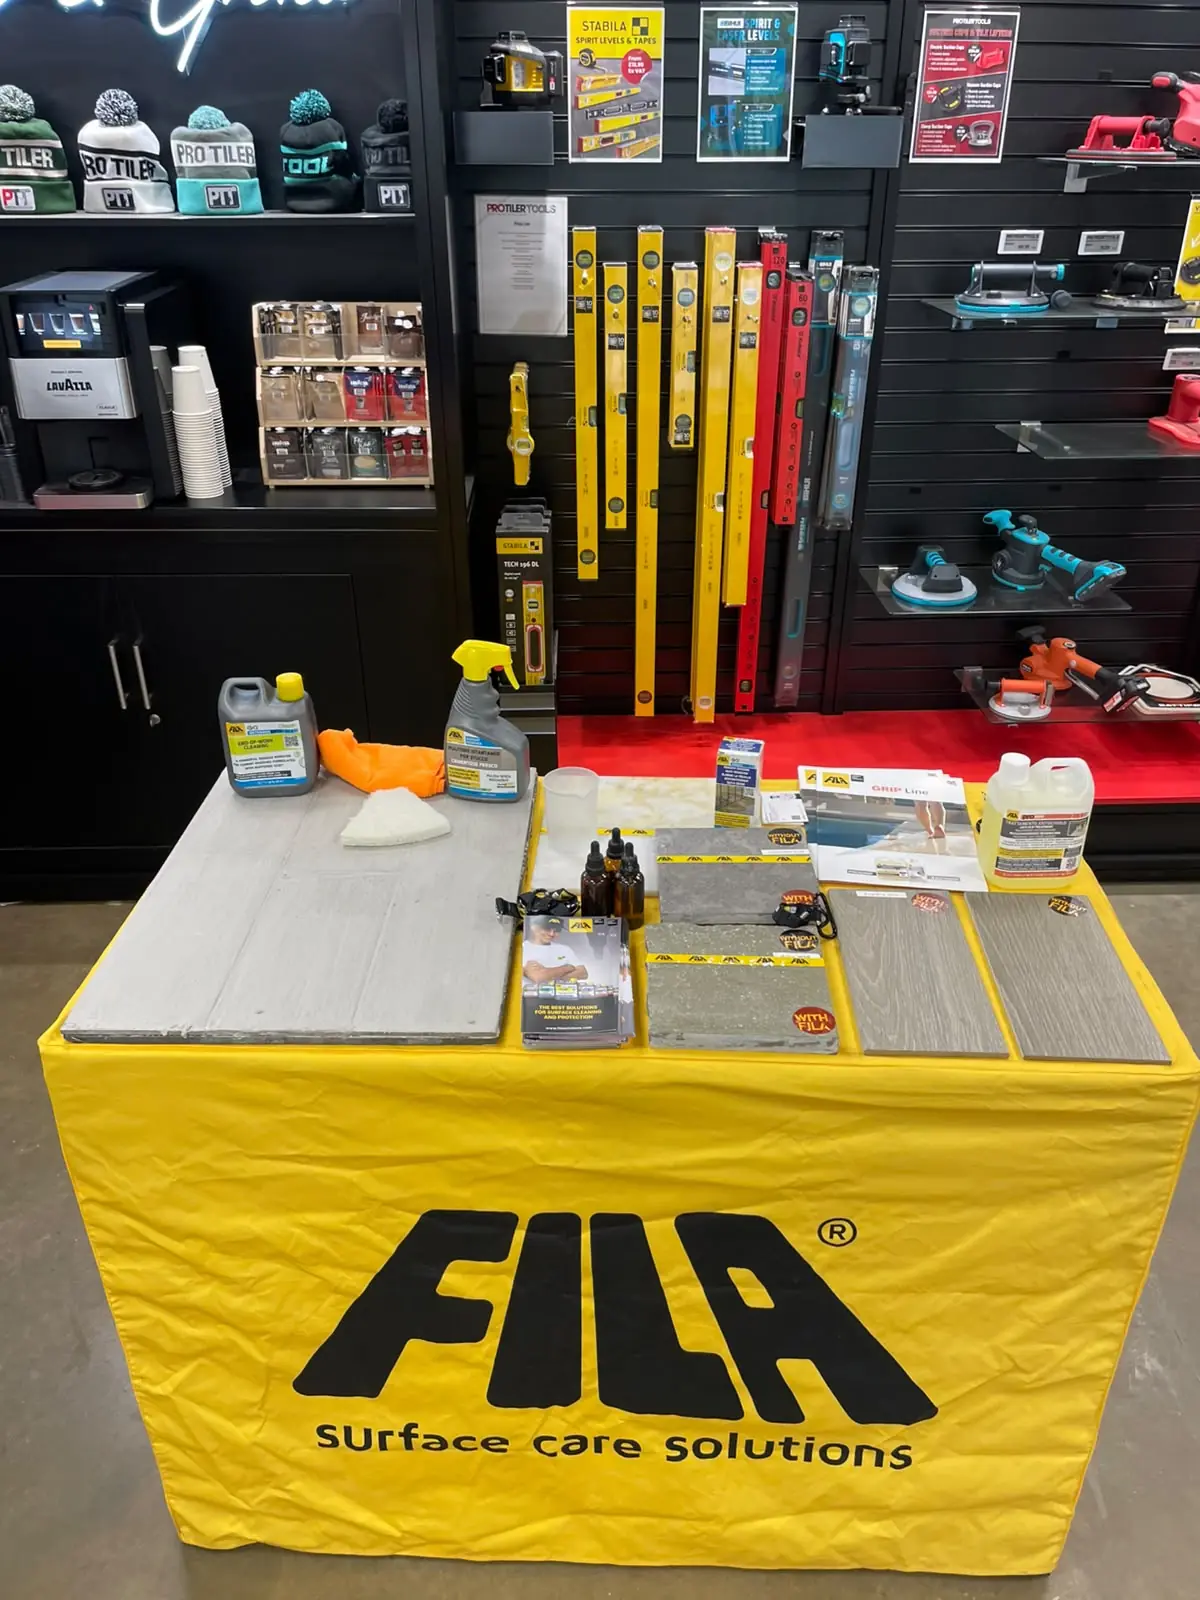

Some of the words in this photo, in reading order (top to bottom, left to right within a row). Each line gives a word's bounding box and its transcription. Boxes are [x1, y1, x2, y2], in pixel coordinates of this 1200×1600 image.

[582, 21, 627, 32] STABILA
[745, 18, 772, 29] SPIRIT
[774, 18, 780, 28] &
[575, 36, 599, 44] SPIRIT
[600, 37, 625, 45] LEVELS
[627, 37, 632, 45] &
[634, 37, 657, 45] TAPES
[717, 30, 746, 41] LASER
[747, 30, 780, 41] LEVELS
[1, 146, 54, 169] TILER
[177, 144, 205, 165] PRO
[208, 144, 256, 164] TILER
[110, 157, 156, 180] TILER
[486, 203, 558, 214] PROTILERTOOLS
[46, 378, 93, 391] LAVAZZA
[503, 560, 519, 568] TECH
[824, 776, 848, 785] FILA
[904, 787, 929, 795] Line
[773, 836, 801, 844] FILA
[784, 939, 817, 950] FILA
[793, 1013, 829, 1023] WITH
[795, 1020, 831, 1032] FILA
[292, 1209, 939, 1426] FILA
[315, 1422, 510, 1454] surface
[532, 1433, 642, 1459] care
[664, 1431, 914, 1470] solutions
